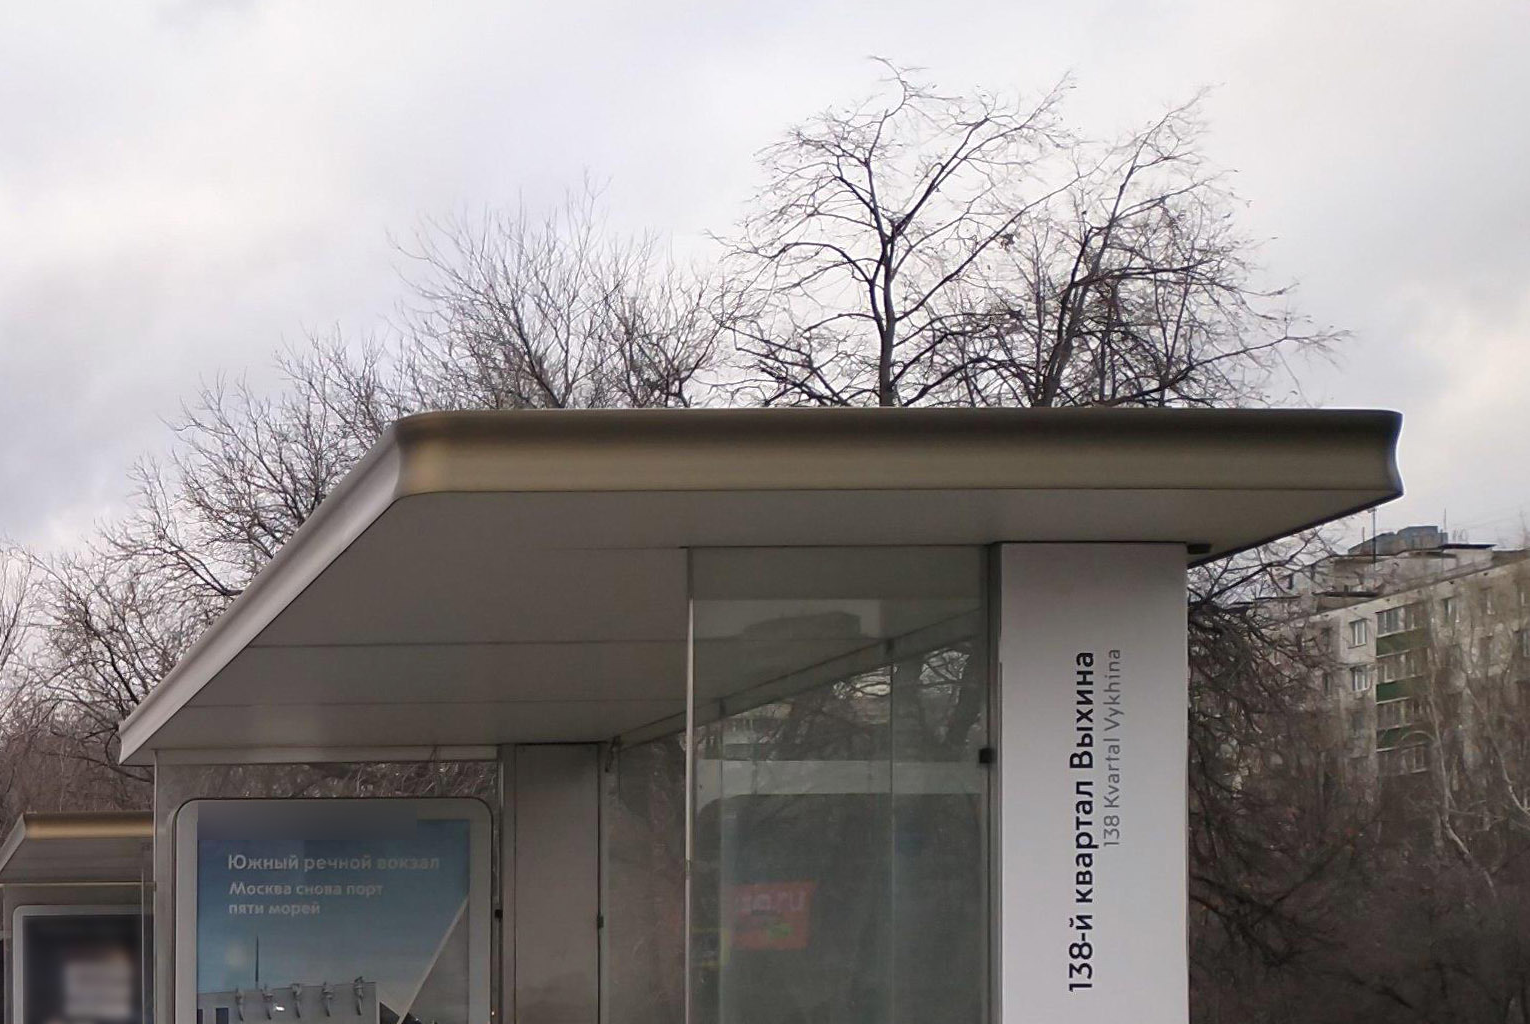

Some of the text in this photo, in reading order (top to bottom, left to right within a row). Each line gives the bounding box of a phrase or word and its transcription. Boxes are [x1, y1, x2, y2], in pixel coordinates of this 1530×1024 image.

[1103, 649, 1124, 847] 138 Kvartal Vykhina
[1068, 651, 1099, 993] 138-й квартал Выхина
[227, 854, 440, 872] Южный речной вокзал
[229, 881, 384, 898] Москва снова порт
[228, 900, 321, 917] пяти морей
